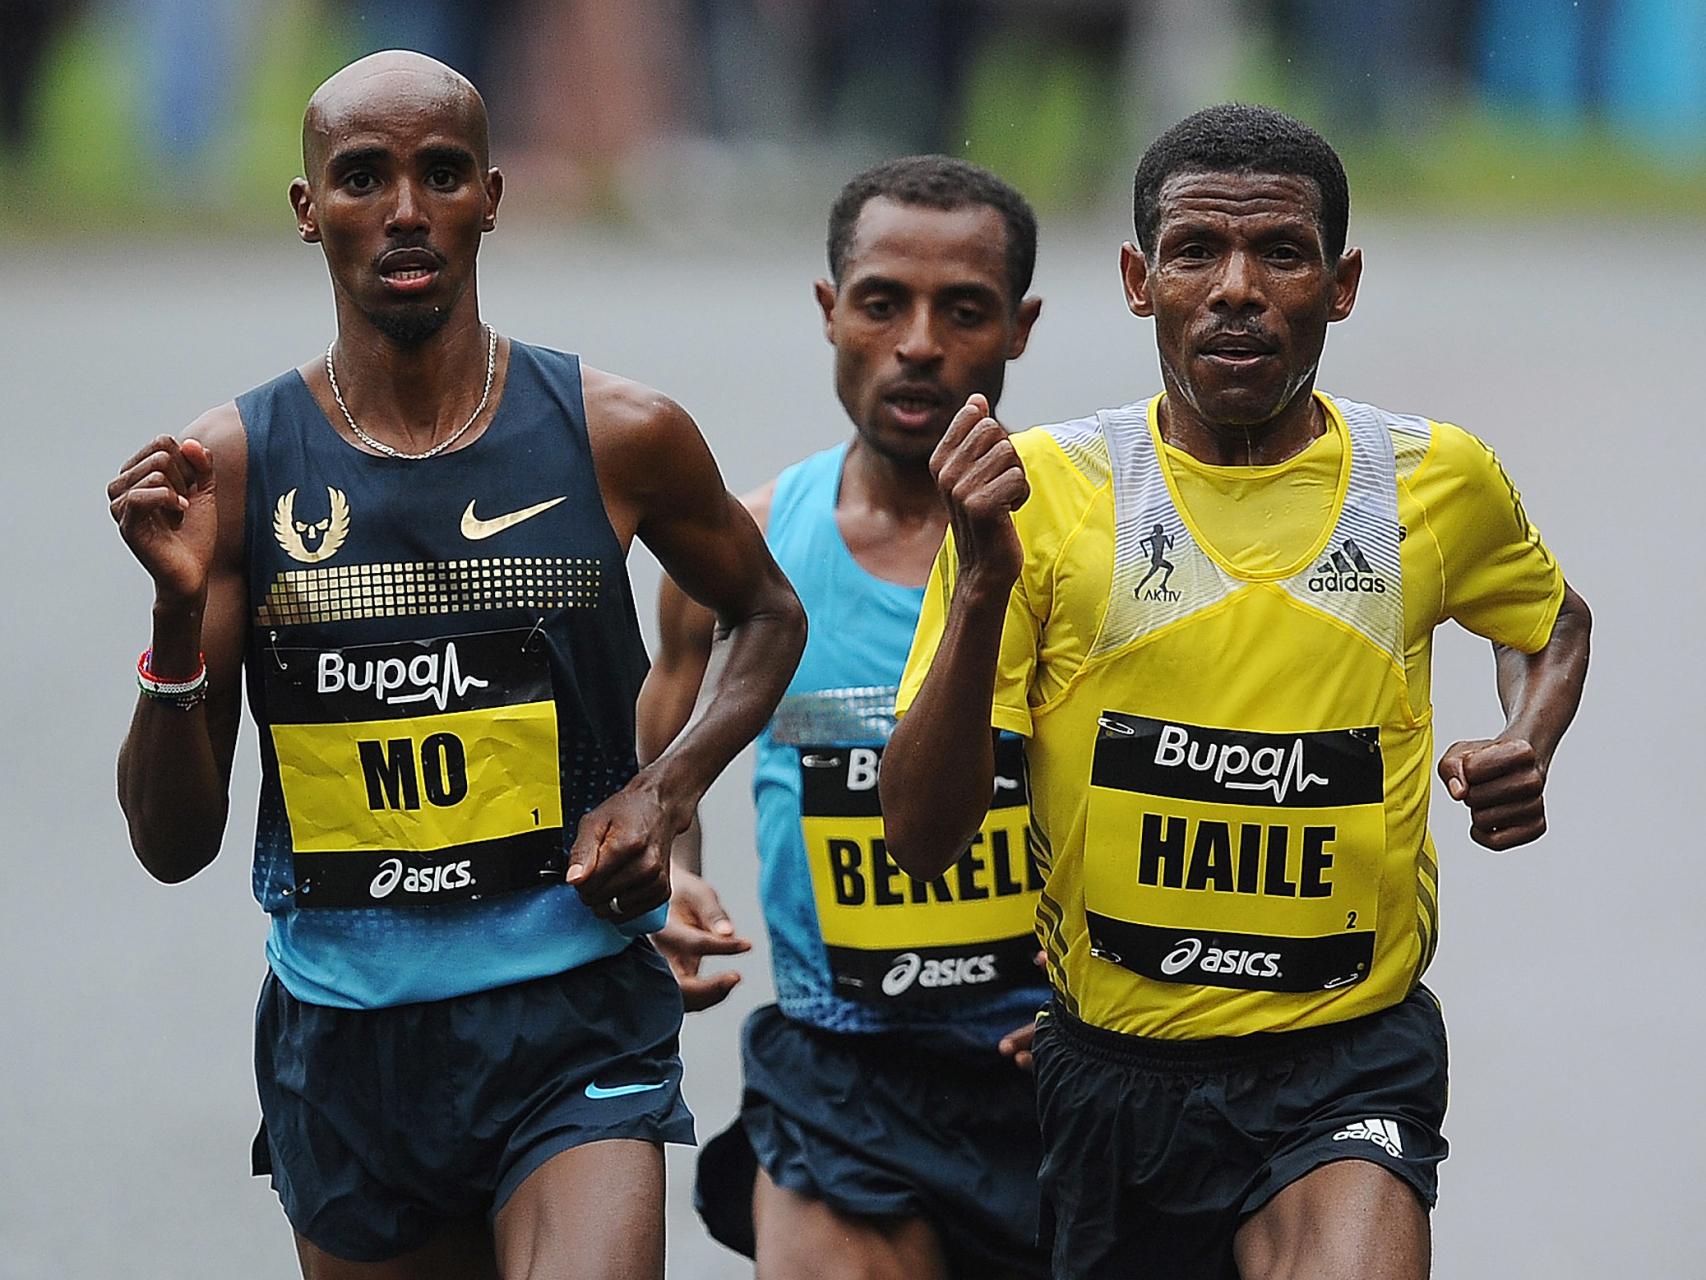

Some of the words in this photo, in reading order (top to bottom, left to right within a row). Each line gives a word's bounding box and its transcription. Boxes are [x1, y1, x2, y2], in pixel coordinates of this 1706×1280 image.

[1308, 572, 1386, 593] adidas
[317, 652, 440, 700] Bupa
[357, 731, 469, 811] MO
[1154, 725, 1285, 783] Bupa
[530, 808, 541, 826] 1
[1138, 813, 1337, 898] HAILE
[1345, 911, 1357, 930] 2
